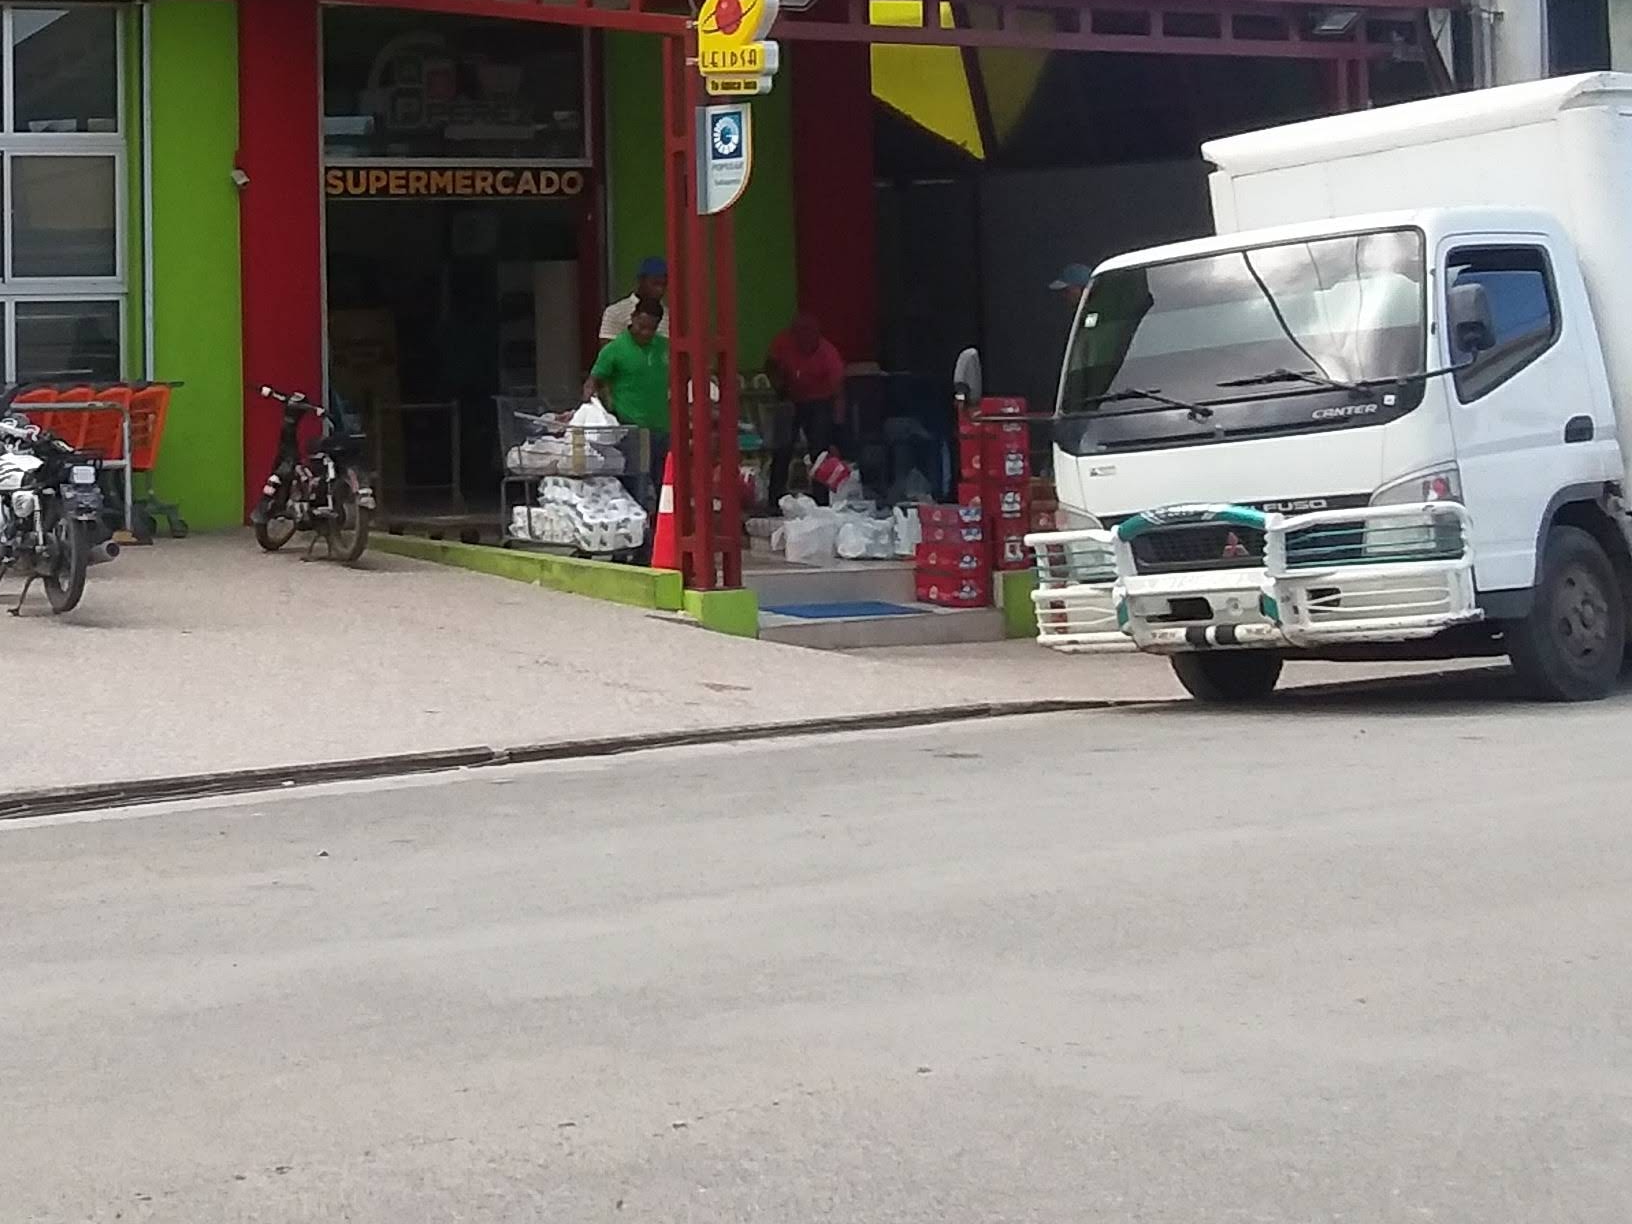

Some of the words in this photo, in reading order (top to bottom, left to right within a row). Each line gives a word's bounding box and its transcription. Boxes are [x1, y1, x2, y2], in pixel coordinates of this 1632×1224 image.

[701, 48, 757, 69] LEIDSA
[325, 169, 584, 196] SUPERMERCADO
[1311, 403, 1378, 419] CANTER
[1262, 499, 1328, 512] FUSO
